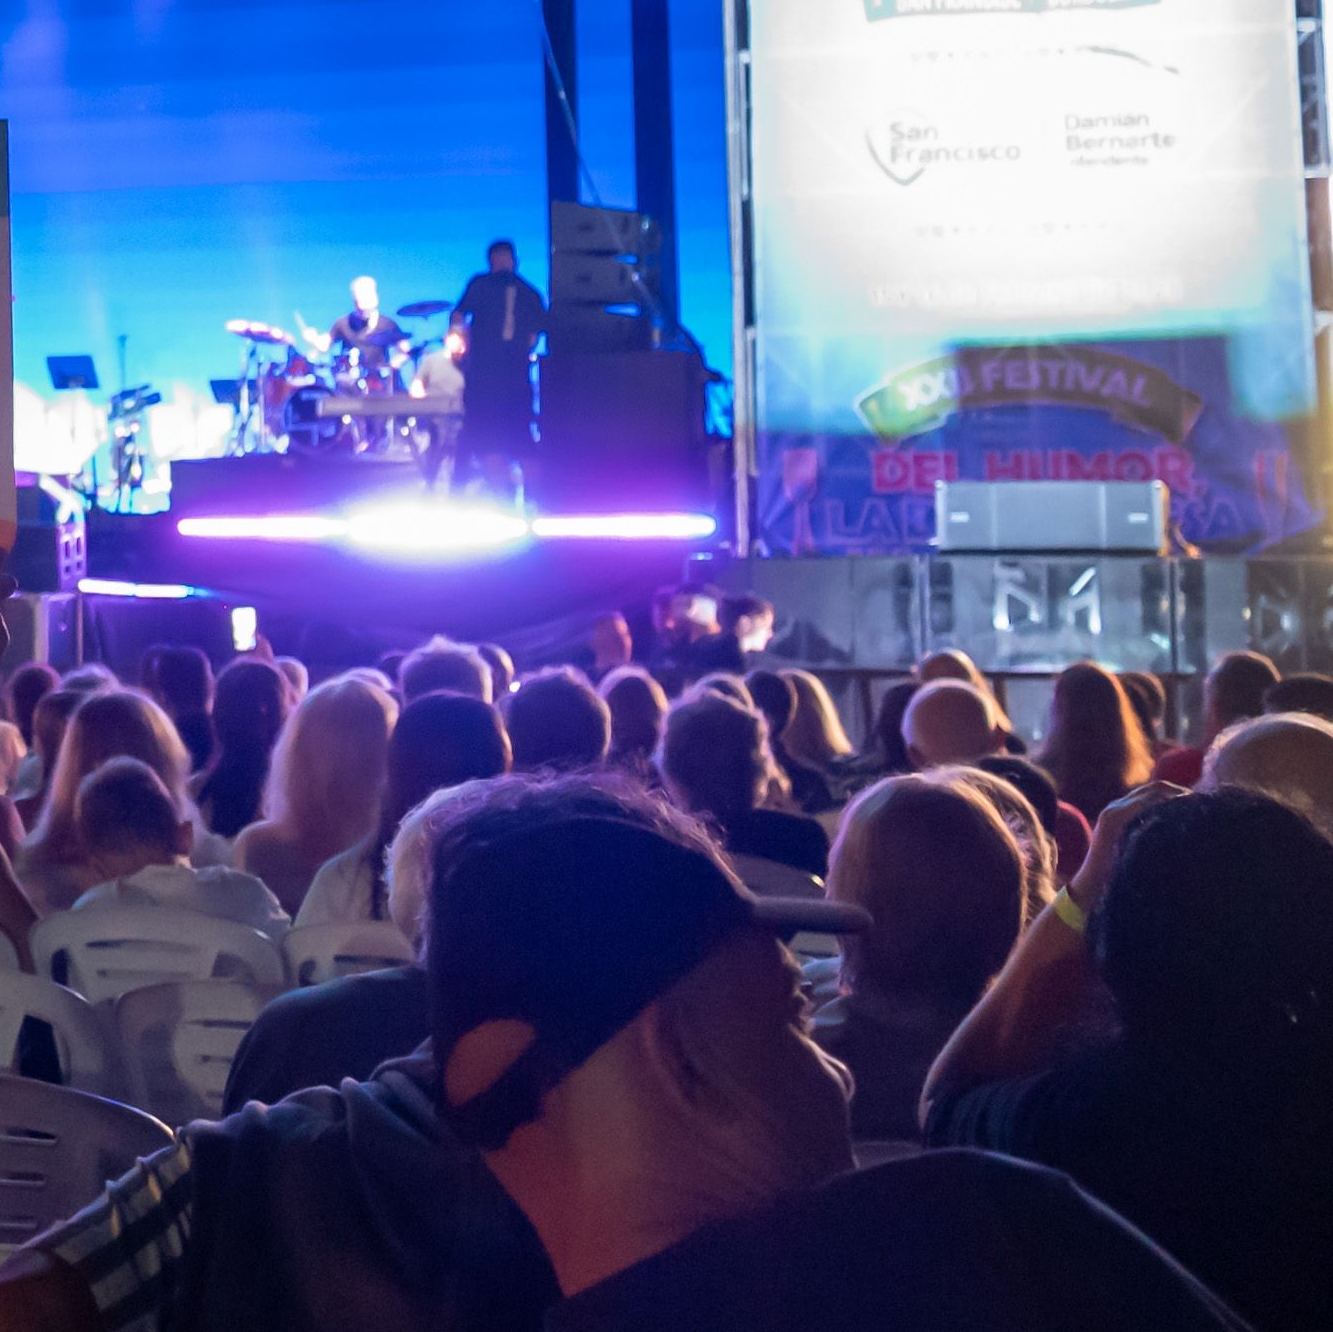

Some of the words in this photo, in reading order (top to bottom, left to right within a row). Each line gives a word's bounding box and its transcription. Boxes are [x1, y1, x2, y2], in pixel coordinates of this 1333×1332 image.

[889, 122, 939, 142] San
[889, 143, 1022, 165] Francisco
[981, 359, 1153, 407] FESTIVAL
